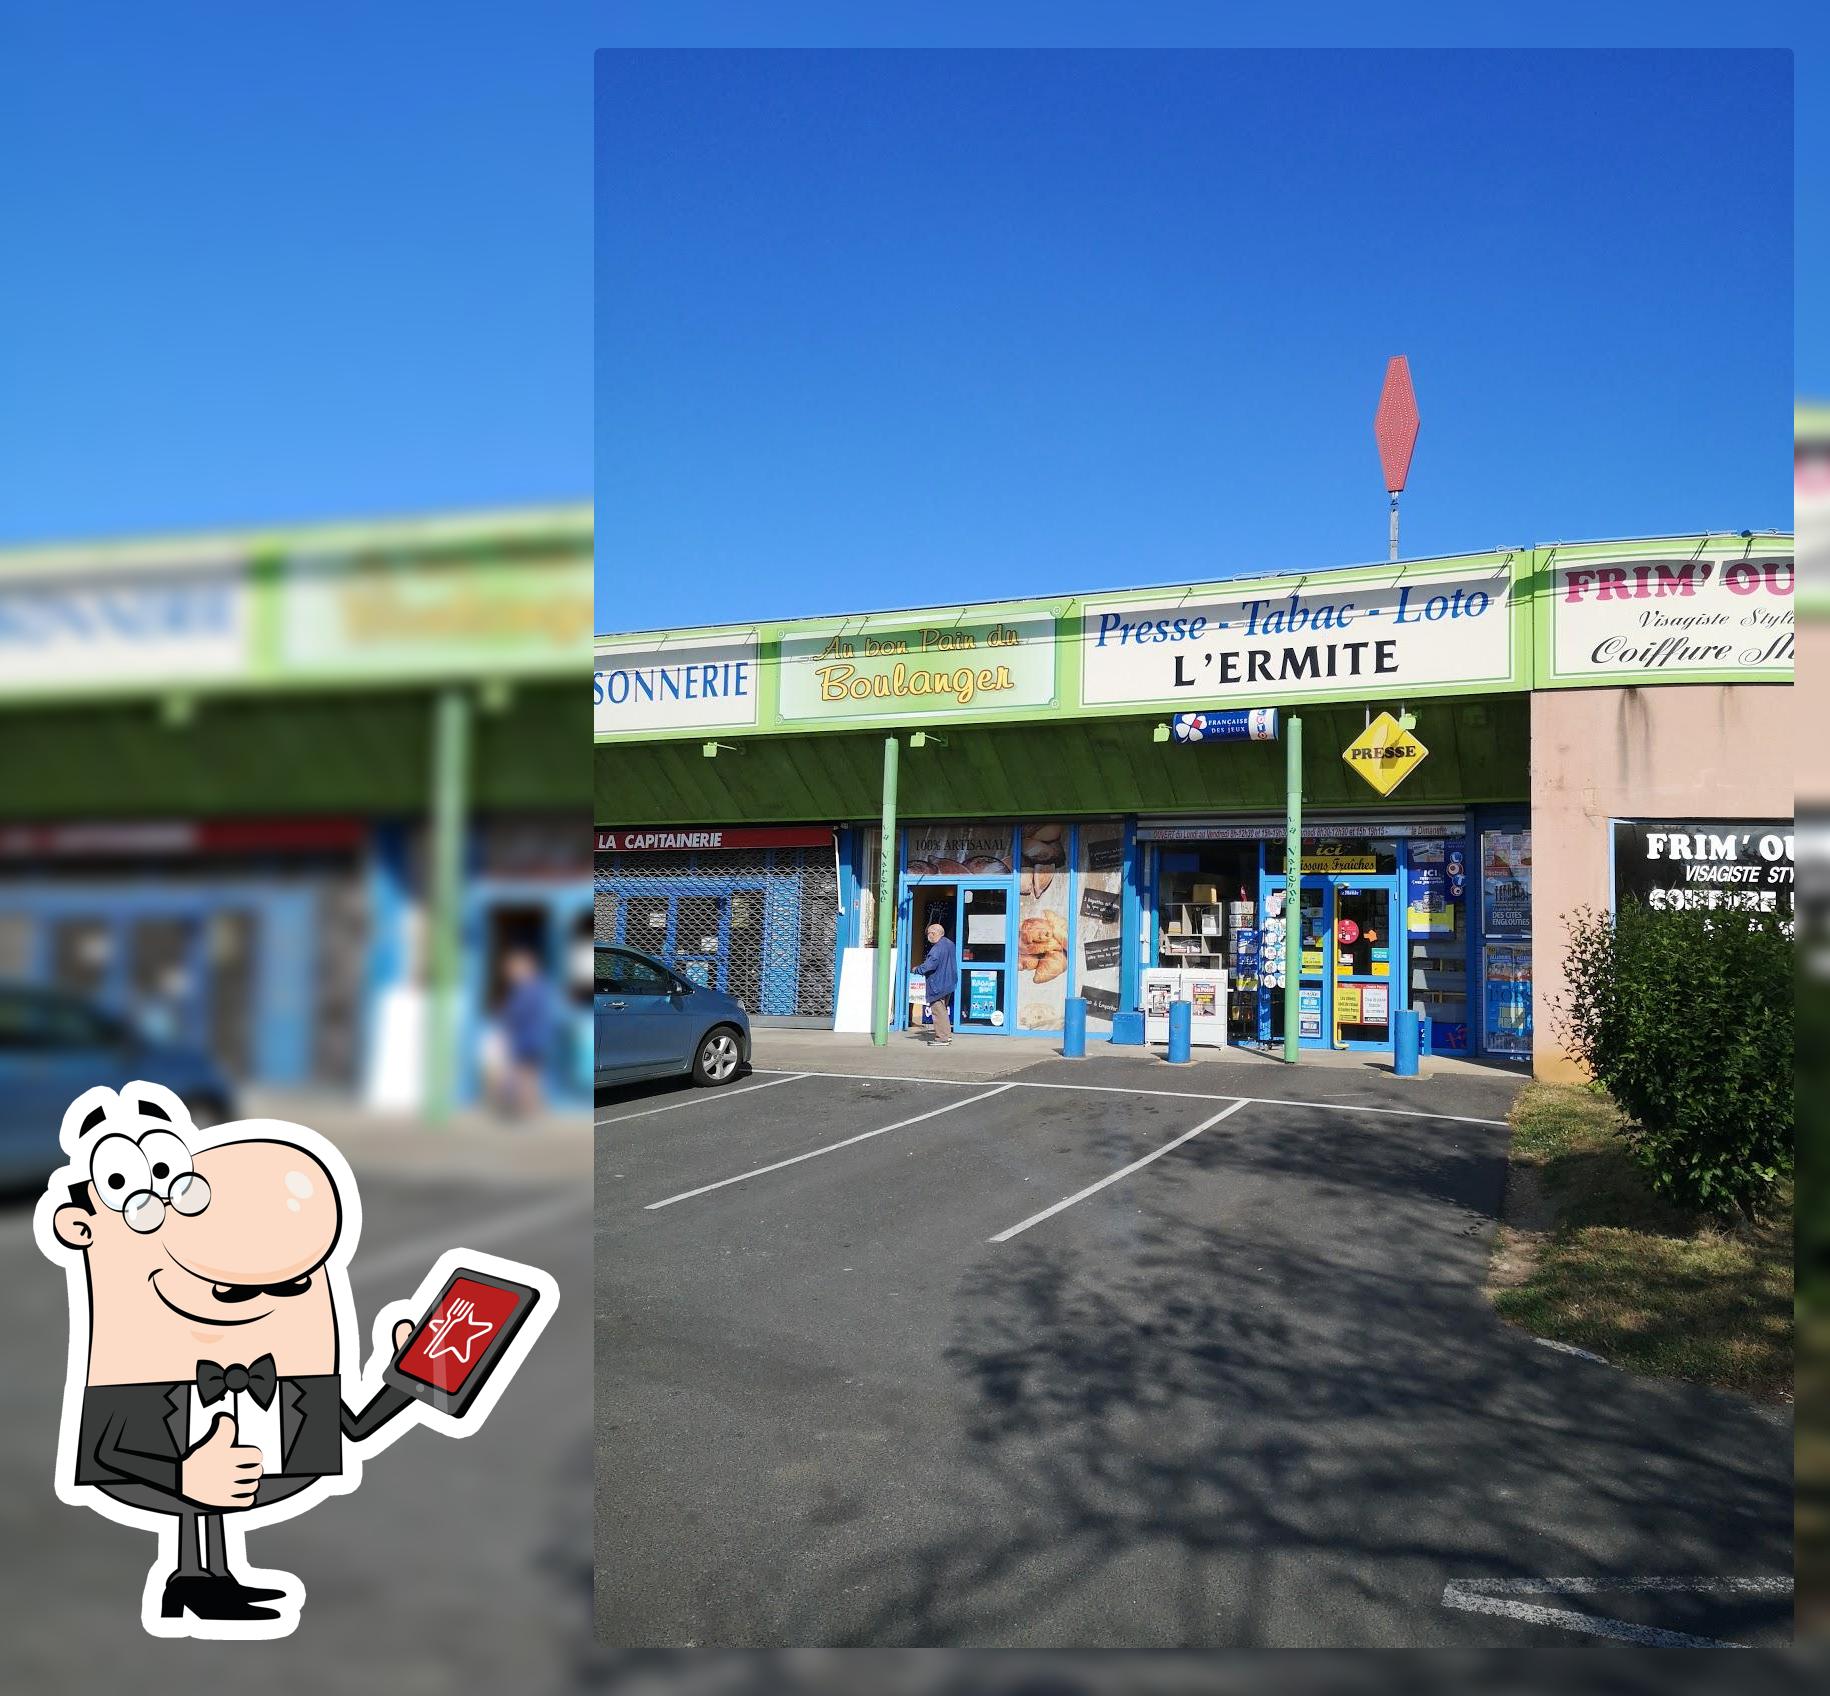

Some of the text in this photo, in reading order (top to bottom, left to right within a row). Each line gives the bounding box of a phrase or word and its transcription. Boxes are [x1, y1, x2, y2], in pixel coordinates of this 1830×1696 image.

[1095, 612, 1208, 648] Presse
[1242, 595, 1355, 636] Tabac
[1392, 586, 1490, 625] Loto
[1638, 610, 1730, 630] Visagiste
[813, 624, 1019, 661] Au bon Pain du
[1591, 635, 1733, 668] Coiffure
[1173, 639, 1400, 687] L'ERMITE
[594, 661, 749, 706] SONNERIE
[815, 662, 1015, 704] Boulanger
[1227, 726, 1246, 734] JEUX
[1351, 745, 1416, 760] PRESSE
[598, 832, 723, 849] LA CAPITAINERIE
[915, 838, 1006, 851] 100% ARTISANAL
[1315, 843, 1345, 856] ici
[1331, 857, 1375, 870] Fraîches
[1685, 865, 1762, 883] VISAGISTE
